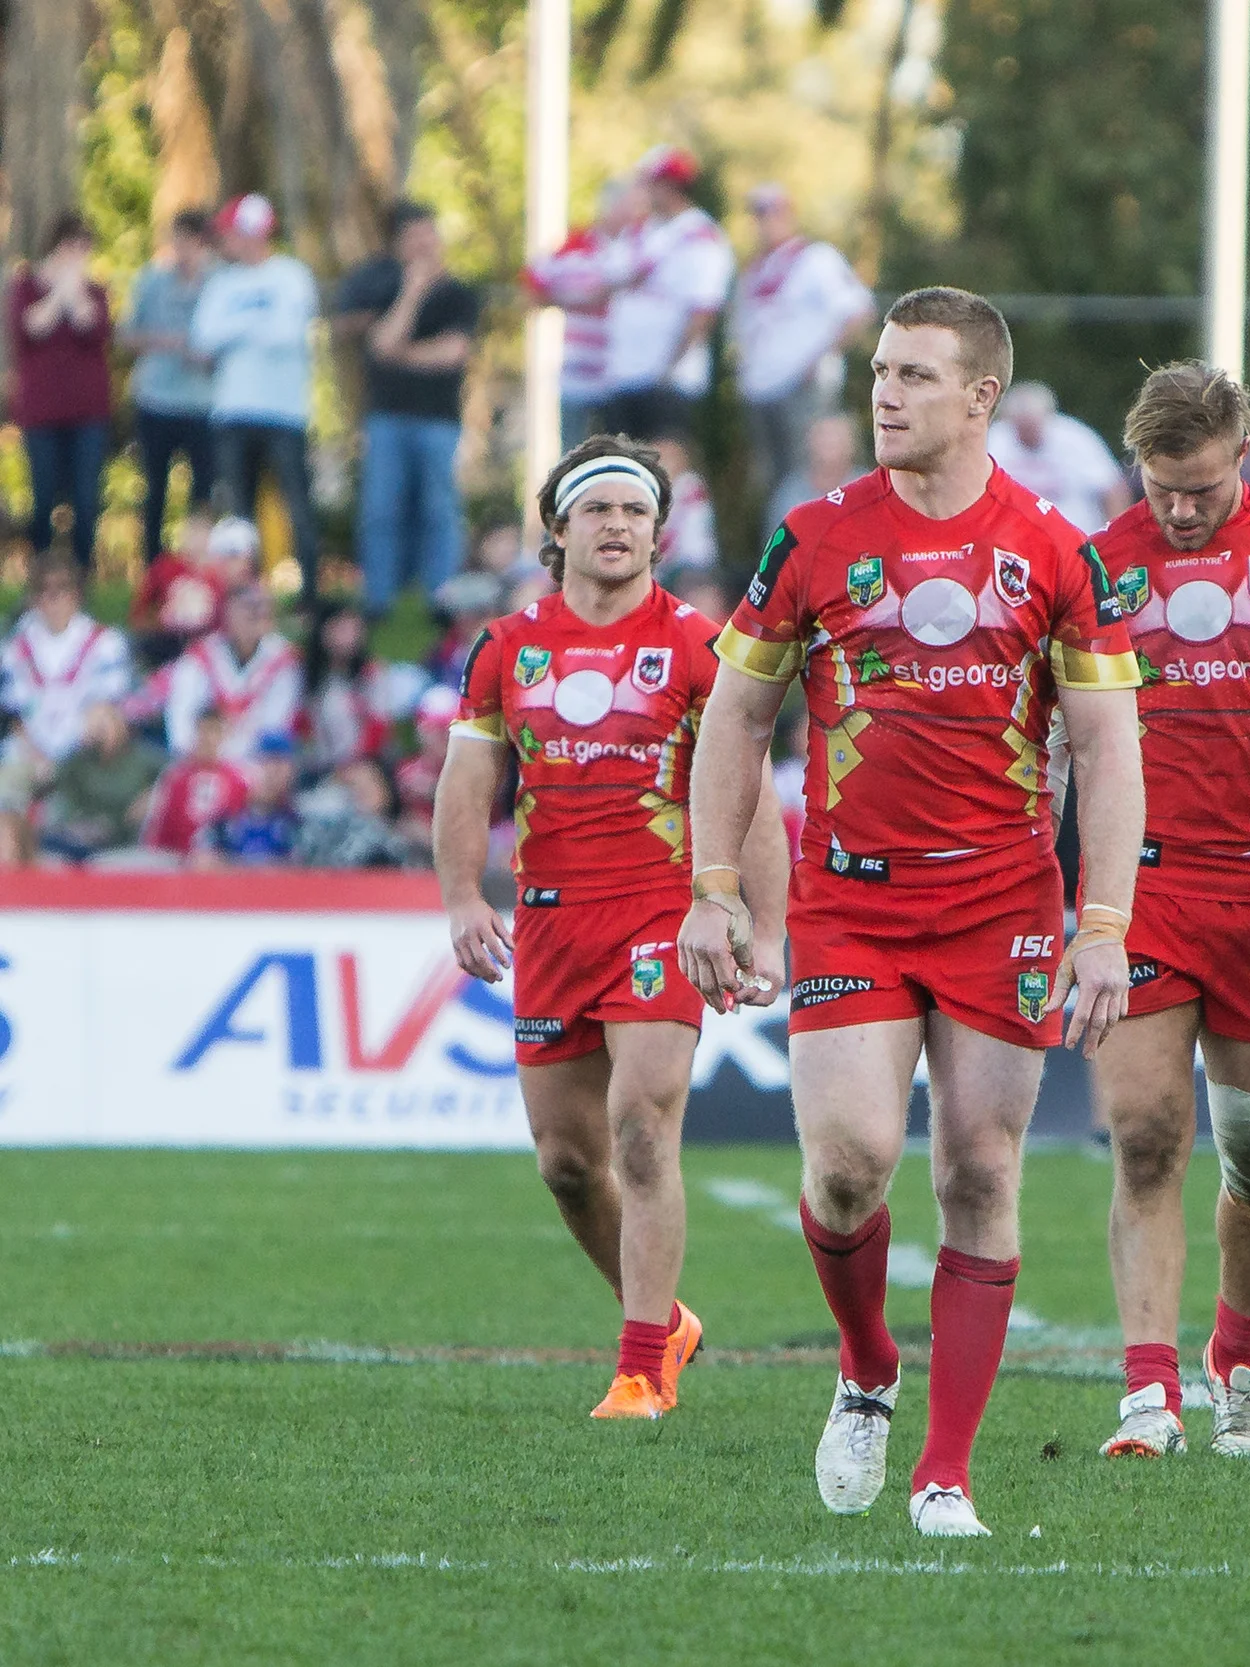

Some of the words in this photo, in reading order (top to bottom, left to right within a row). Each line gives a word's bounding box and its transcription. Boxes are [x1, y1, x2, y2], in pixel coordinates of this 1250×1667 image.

[902, 551, 939, 562] KUMHO
[941, 550, 965, 560] TYRE
[1165, 558, 1199, 569] KUMHO
[1201, 556, 1223, 565] TYRE
[853, 563, 877, 577] NRL
[893, 661, 1024, 692] st.george
[545, 737, 662, 764] st.george
[860, 857, 884, 871] ISC
[1010, 935, 1055, 958] ISC
